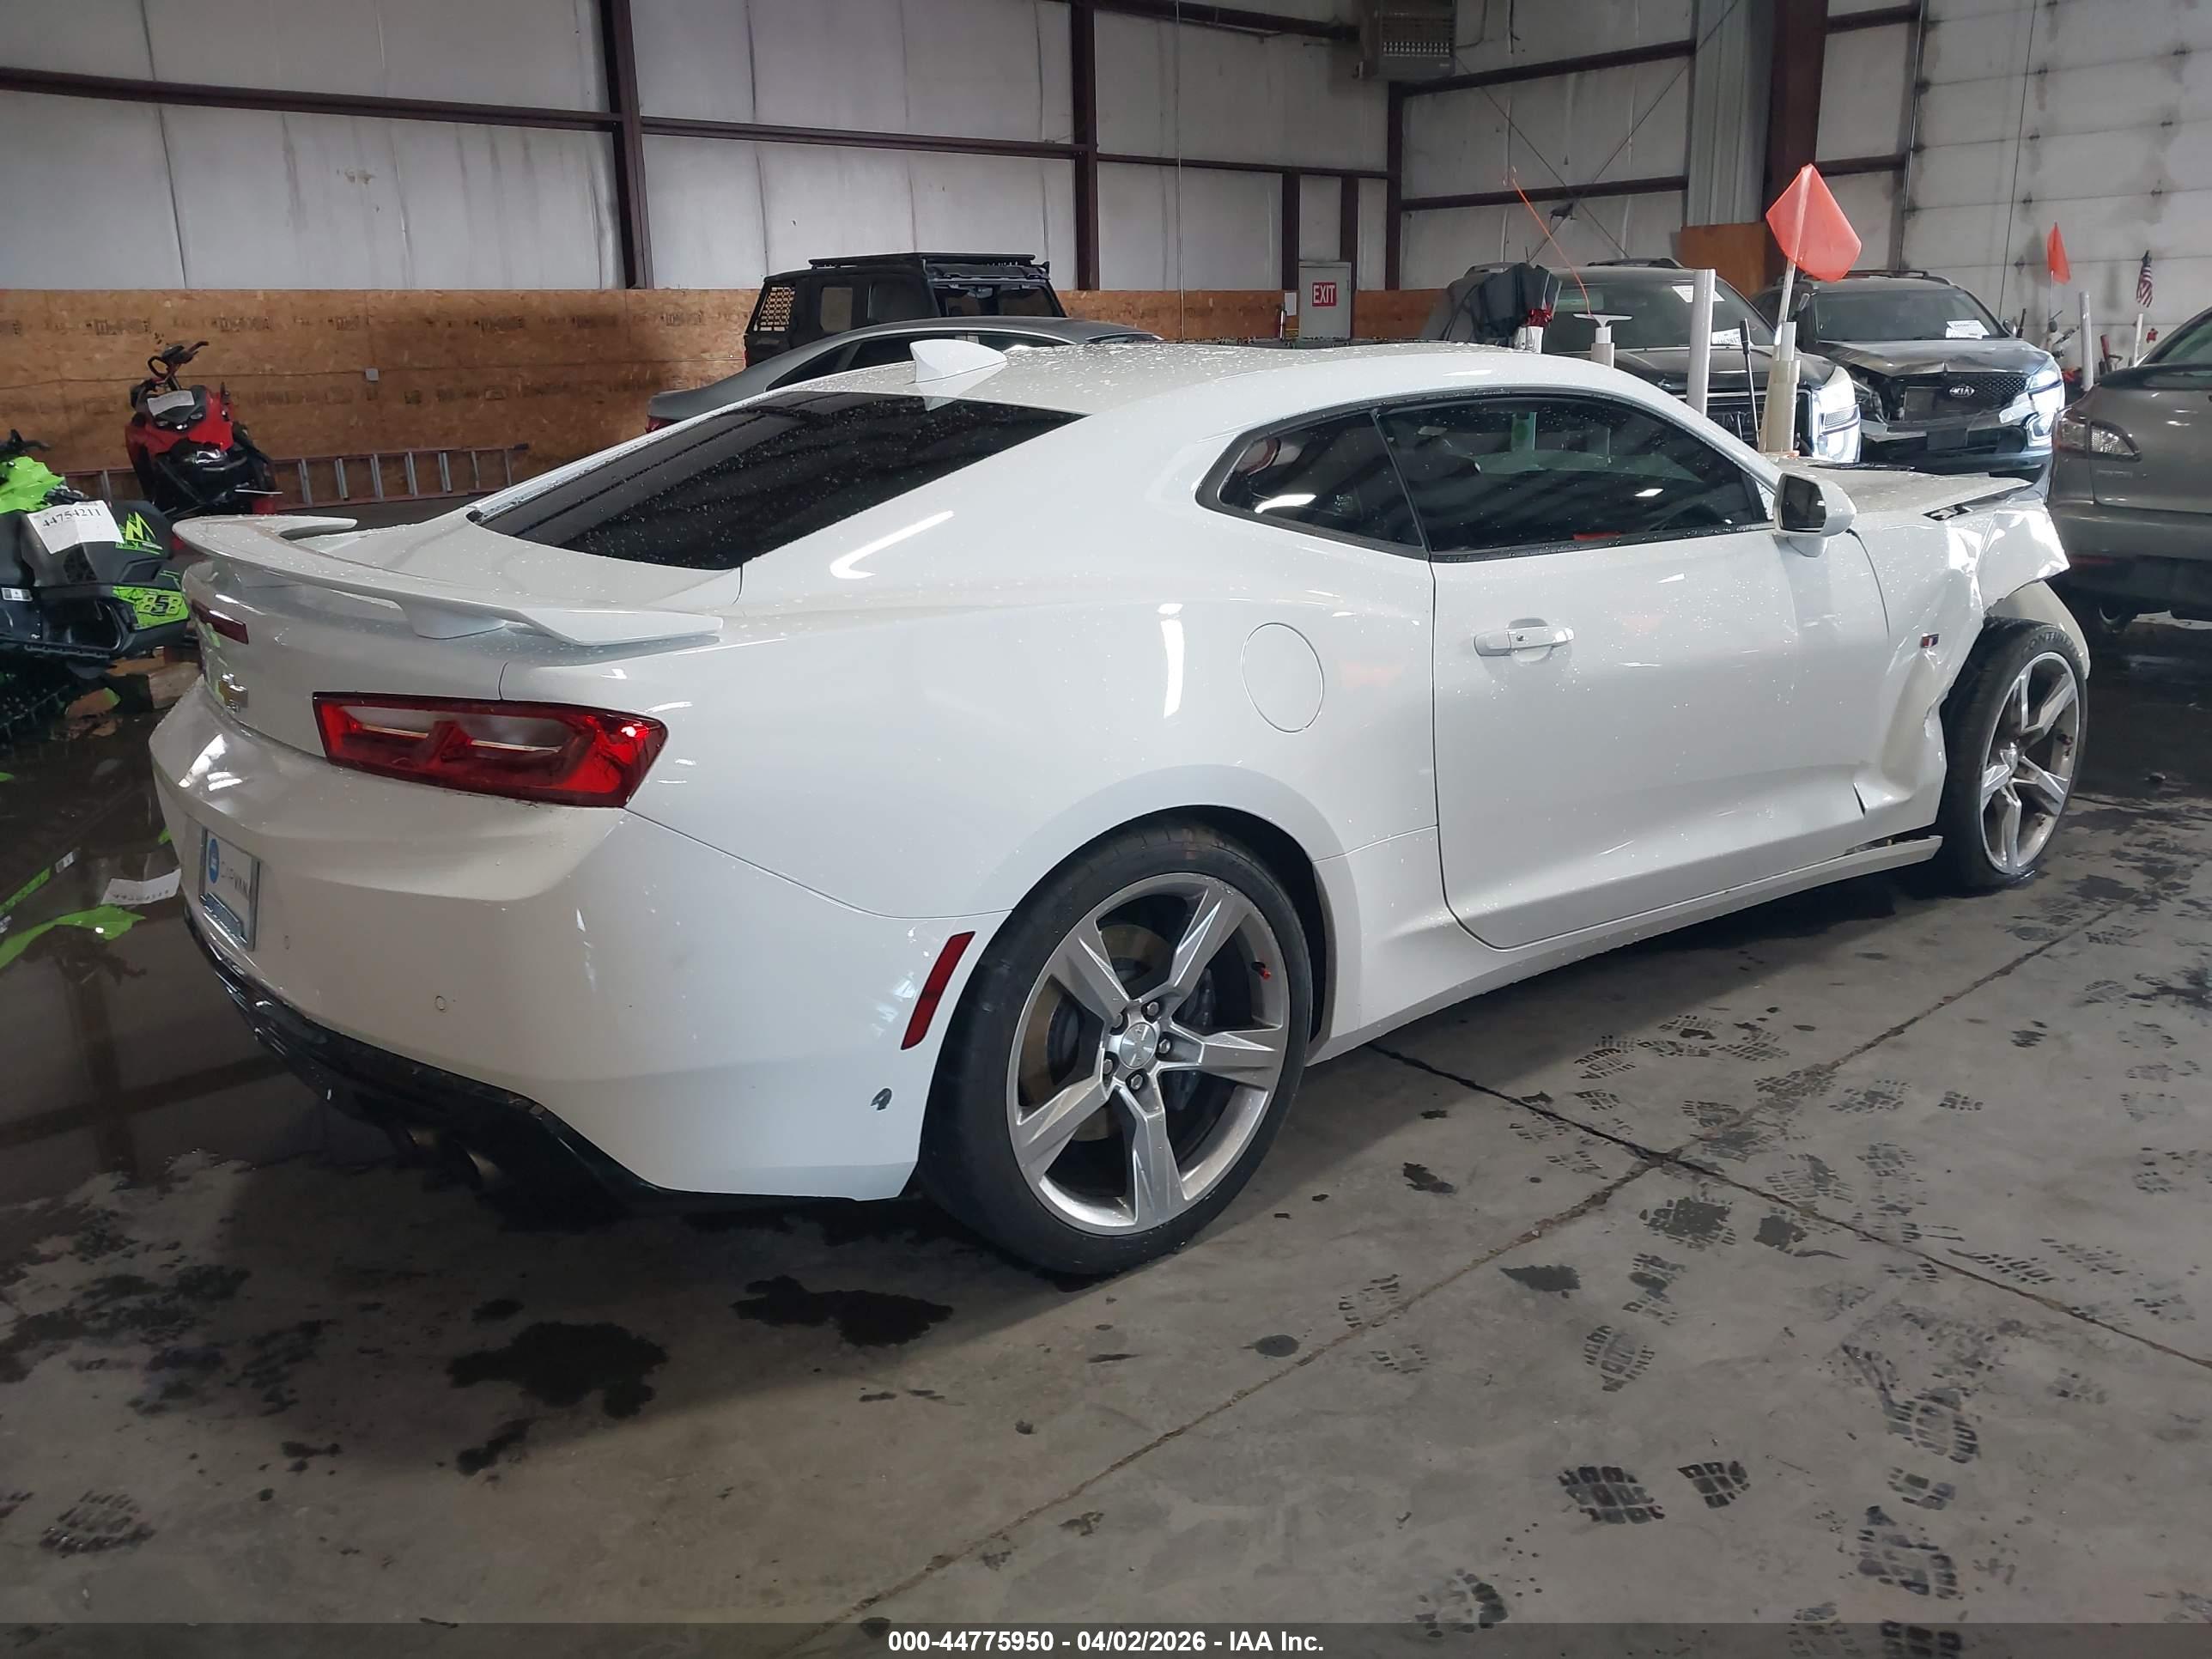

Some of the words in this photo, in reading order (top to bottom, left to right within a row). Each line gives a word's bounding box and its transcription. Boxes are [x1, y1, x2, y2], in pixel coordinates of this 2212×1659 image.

[1313, 284, 1335, 304] EXIT
[1950, 386, 1974, 396] KIA
[43, 508, 102, 527] 44754211
[138, 594, 182, 617] 858
